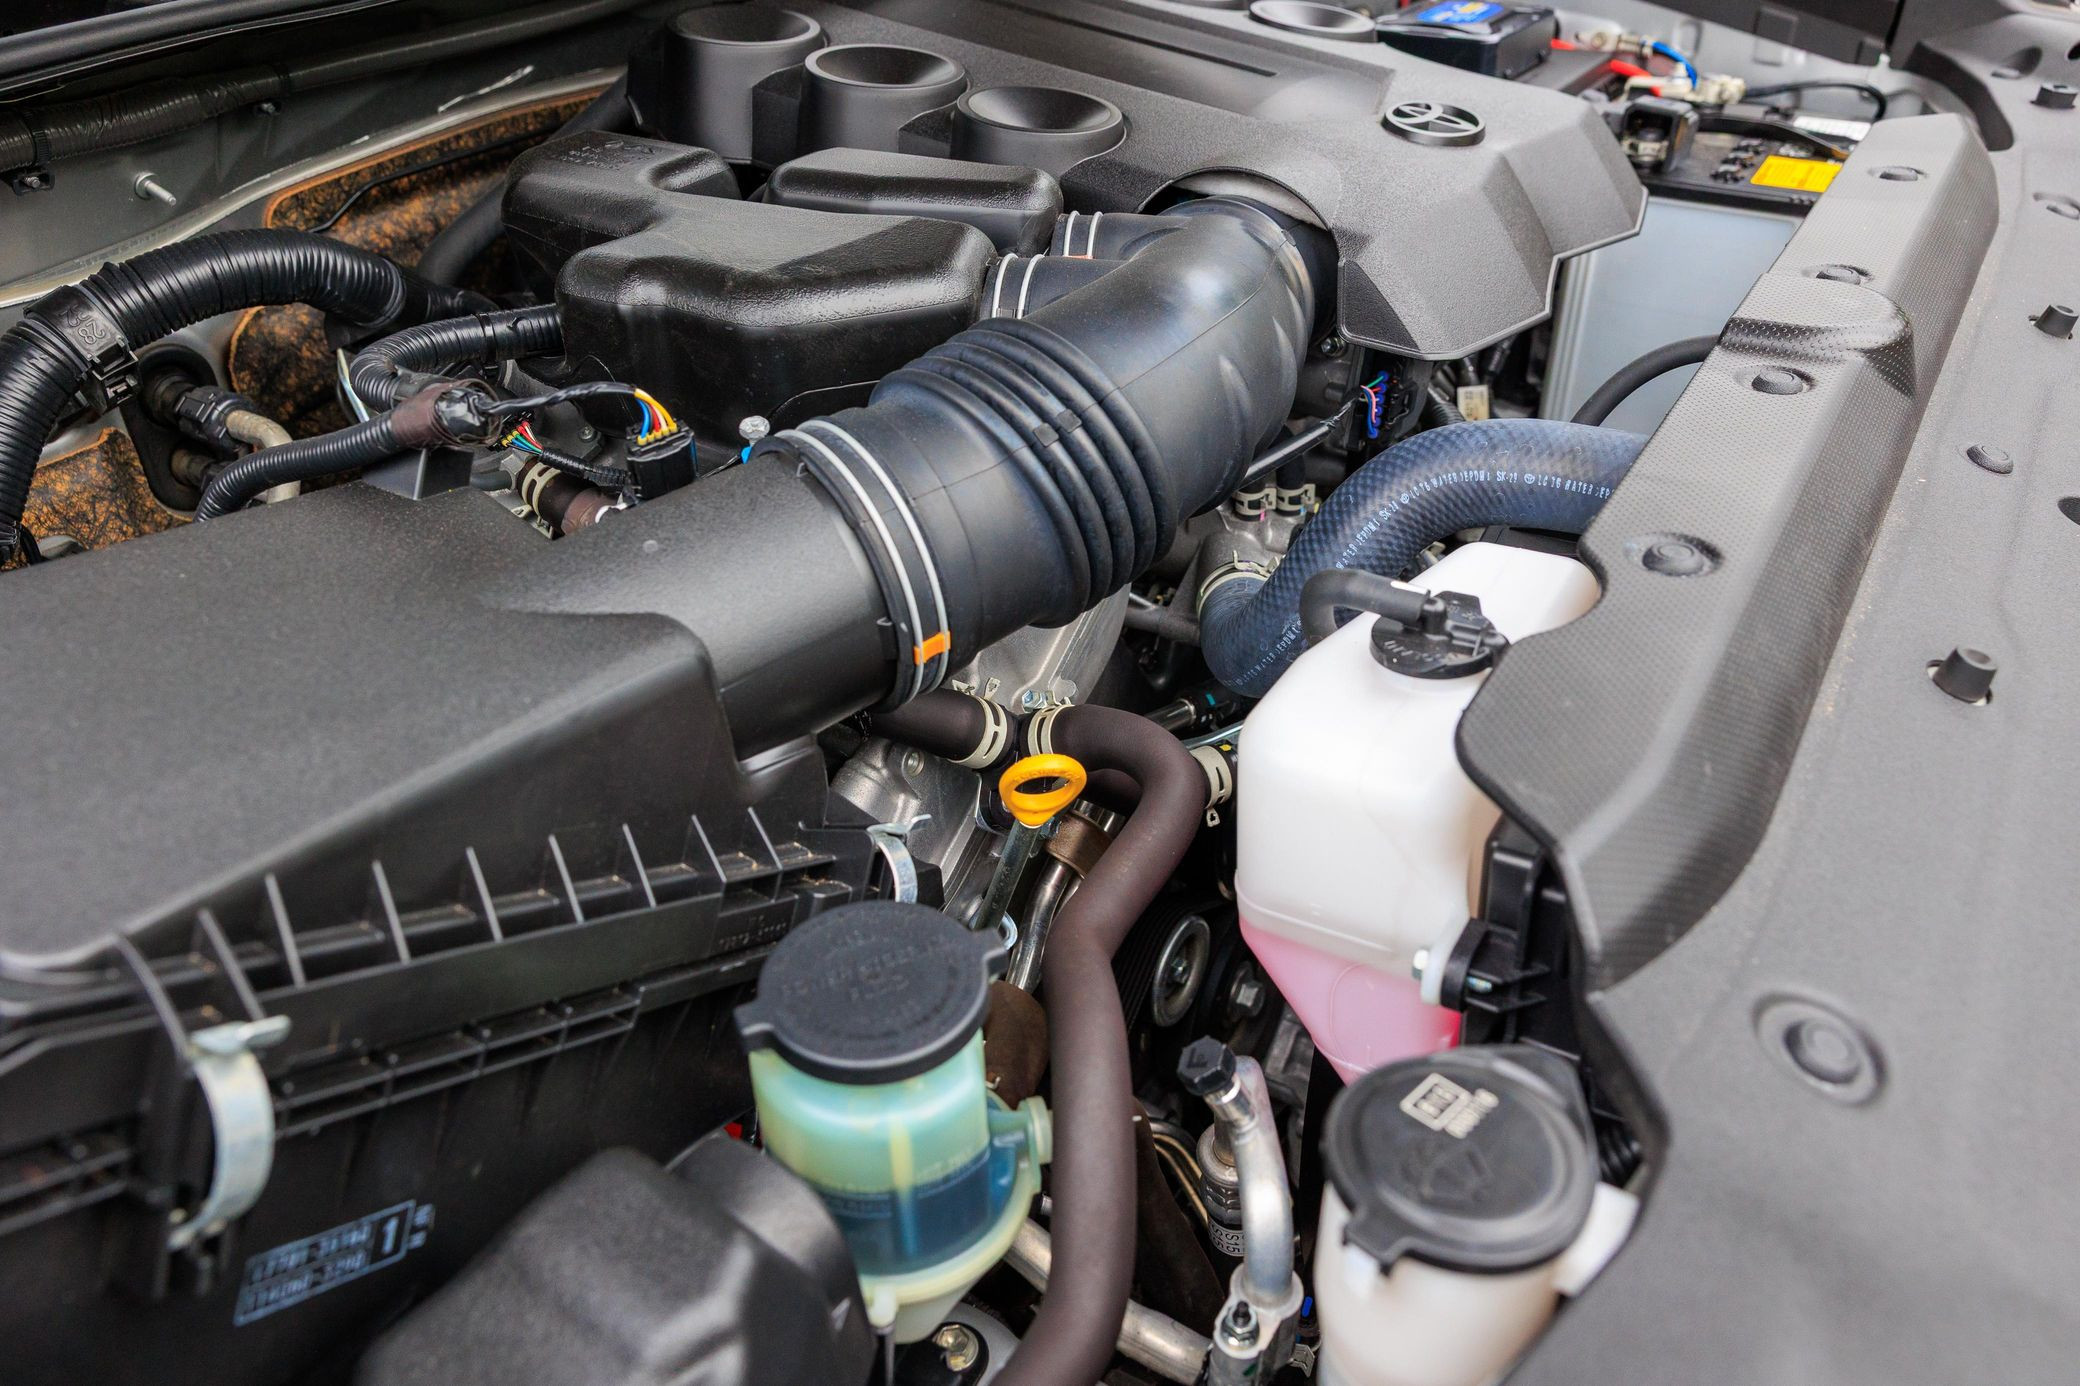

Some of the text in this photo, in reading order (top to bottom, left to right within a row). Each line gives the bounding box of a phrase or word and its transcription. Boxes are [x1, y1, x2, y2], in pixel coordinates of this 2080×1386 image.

[78, 319, 106, 345] 28
[1430, 472, 1458, 488] WATER
[1564, 479, 1593, 495] WATER
[382, 1215, 399, 1255] 1
[1225, 1233, 1240, 1253] S15
